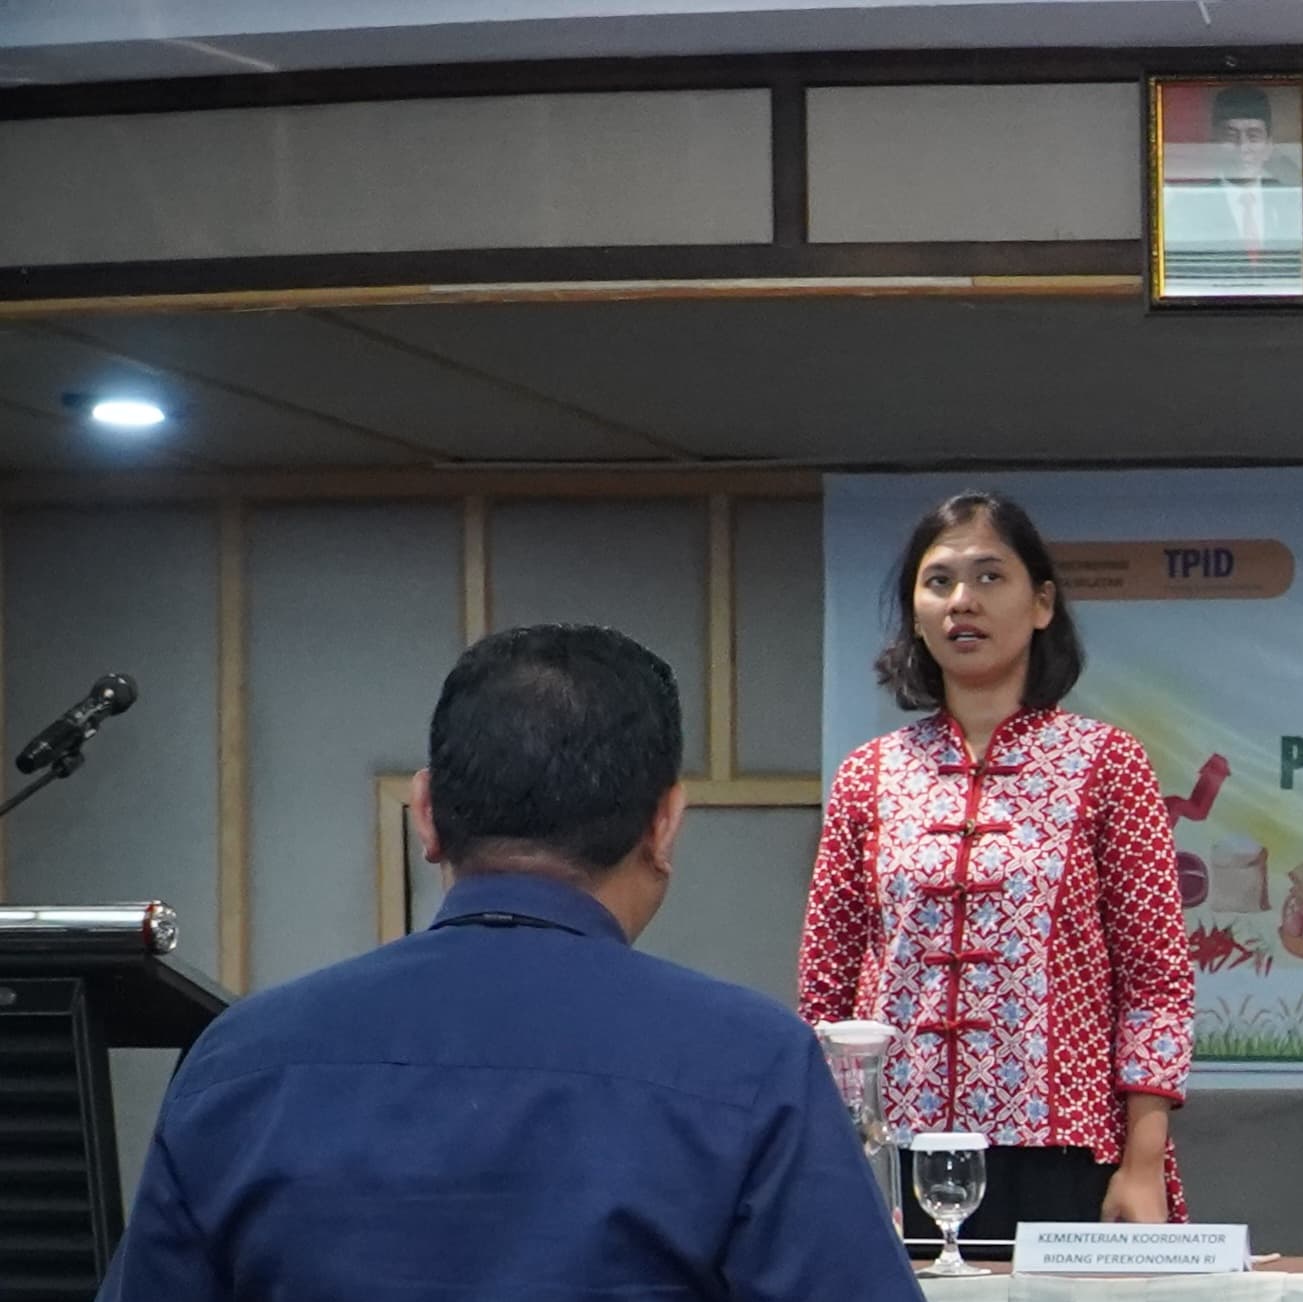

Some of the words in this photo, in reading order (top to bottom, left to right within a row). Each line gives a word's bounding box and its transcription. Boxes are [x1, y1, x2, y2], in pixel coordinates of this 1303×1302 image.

[1164, 549, 1234, 578] TPID
[1038, 1232, 1128, 1244] KEMENTERIAN
[1132, 1232, 1226, 1245] KOORDINATOR
[1043, 1253, 1092, 1264] BIDANG
[1097, 1253, 1199, 1265] PEREKONOMIAN
[1203, 1254, 1216, 1265] RI
